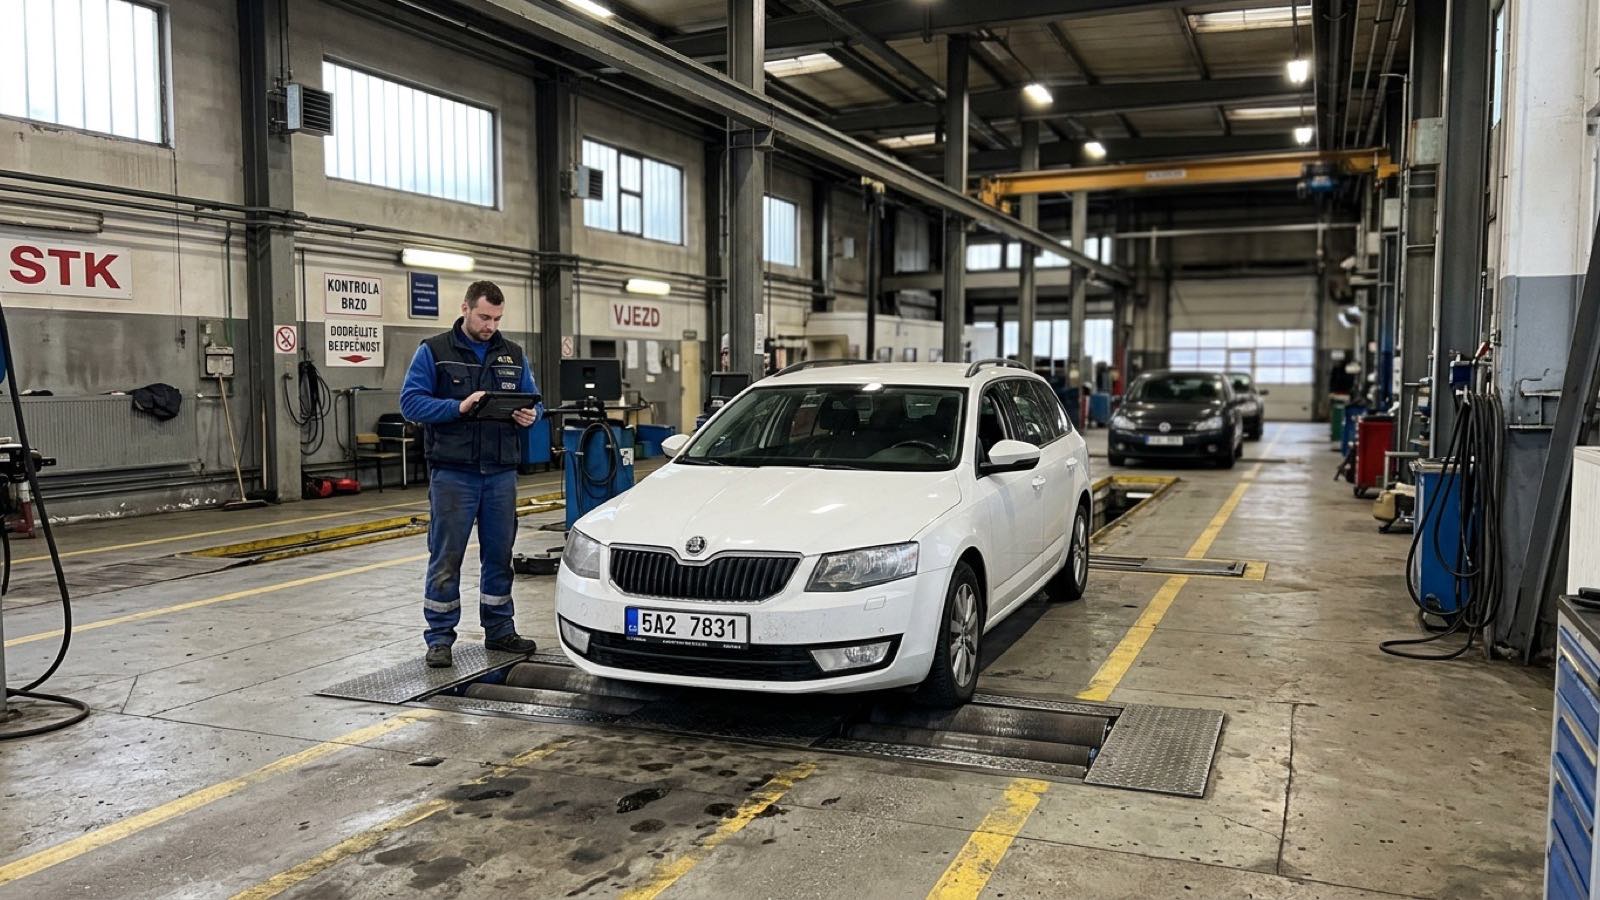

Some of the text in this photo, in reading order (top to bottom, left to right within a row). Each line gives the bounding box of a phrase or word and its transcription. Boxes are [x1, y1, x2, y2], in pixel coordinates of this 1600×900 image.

[9, 245, 121, 289] STK
[327, 279, 380, 294] KONTROLA
[341, 297, 367, 310] BRZO
[614, 304, 660, 327] VJEZD
[642, 613, 736, 640] 5A2 7831
